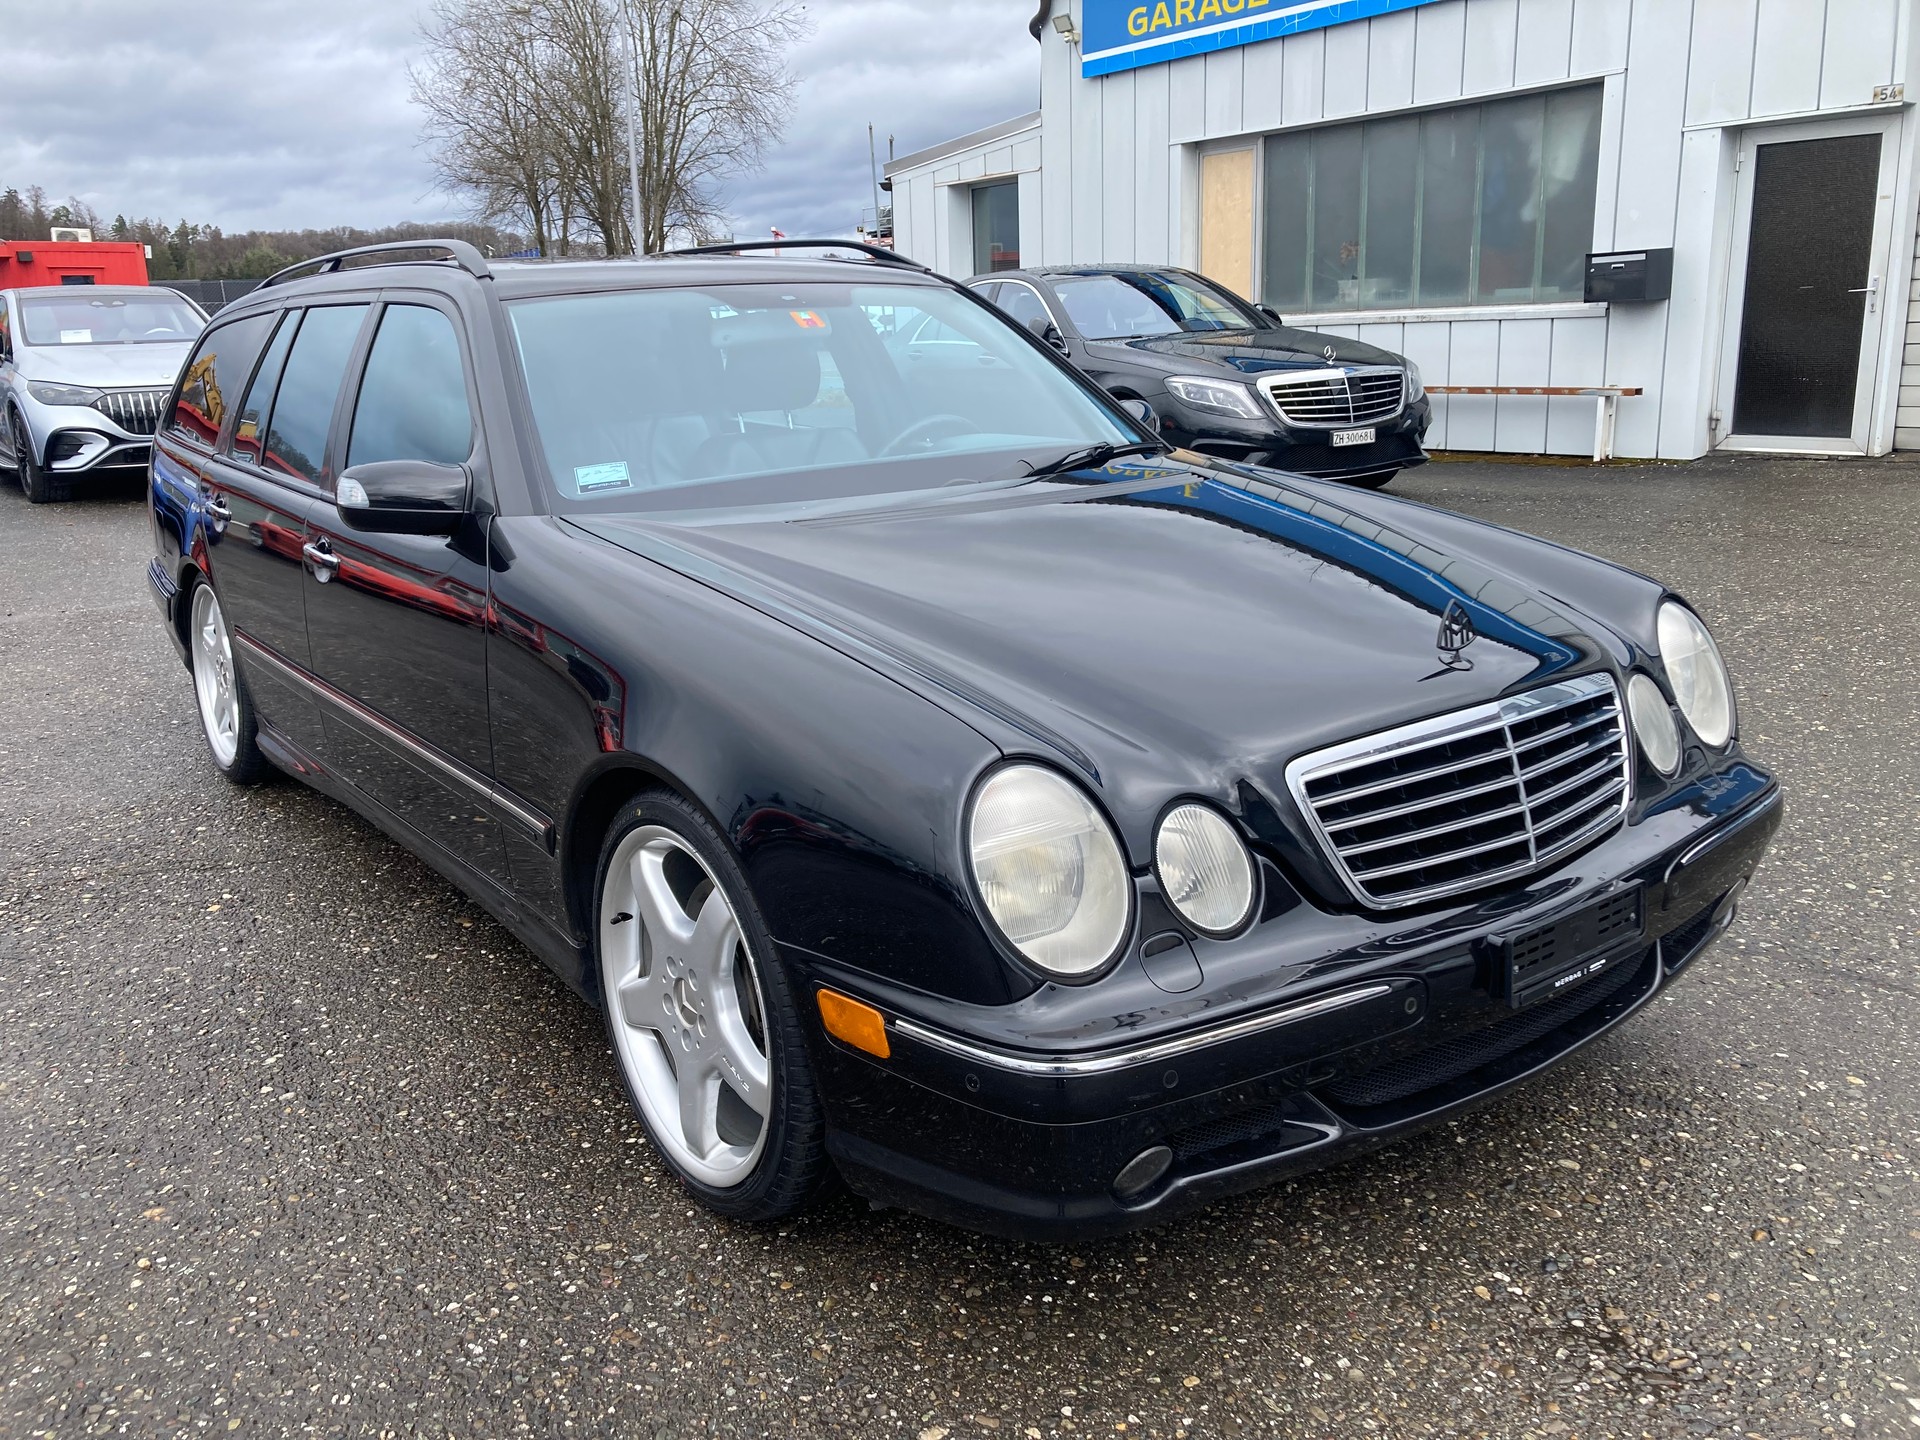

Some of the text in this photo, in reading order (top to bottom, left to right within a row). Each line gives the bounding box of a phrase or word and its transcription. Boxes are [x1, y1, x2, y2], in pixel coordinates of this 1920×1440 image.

[1127, 0, 1269, 36] GARA
[1880, 87, 1897, 100] 54
[1334, 433, 1344, 445] ZH
[1345, 431, 1369, 443] 30068
